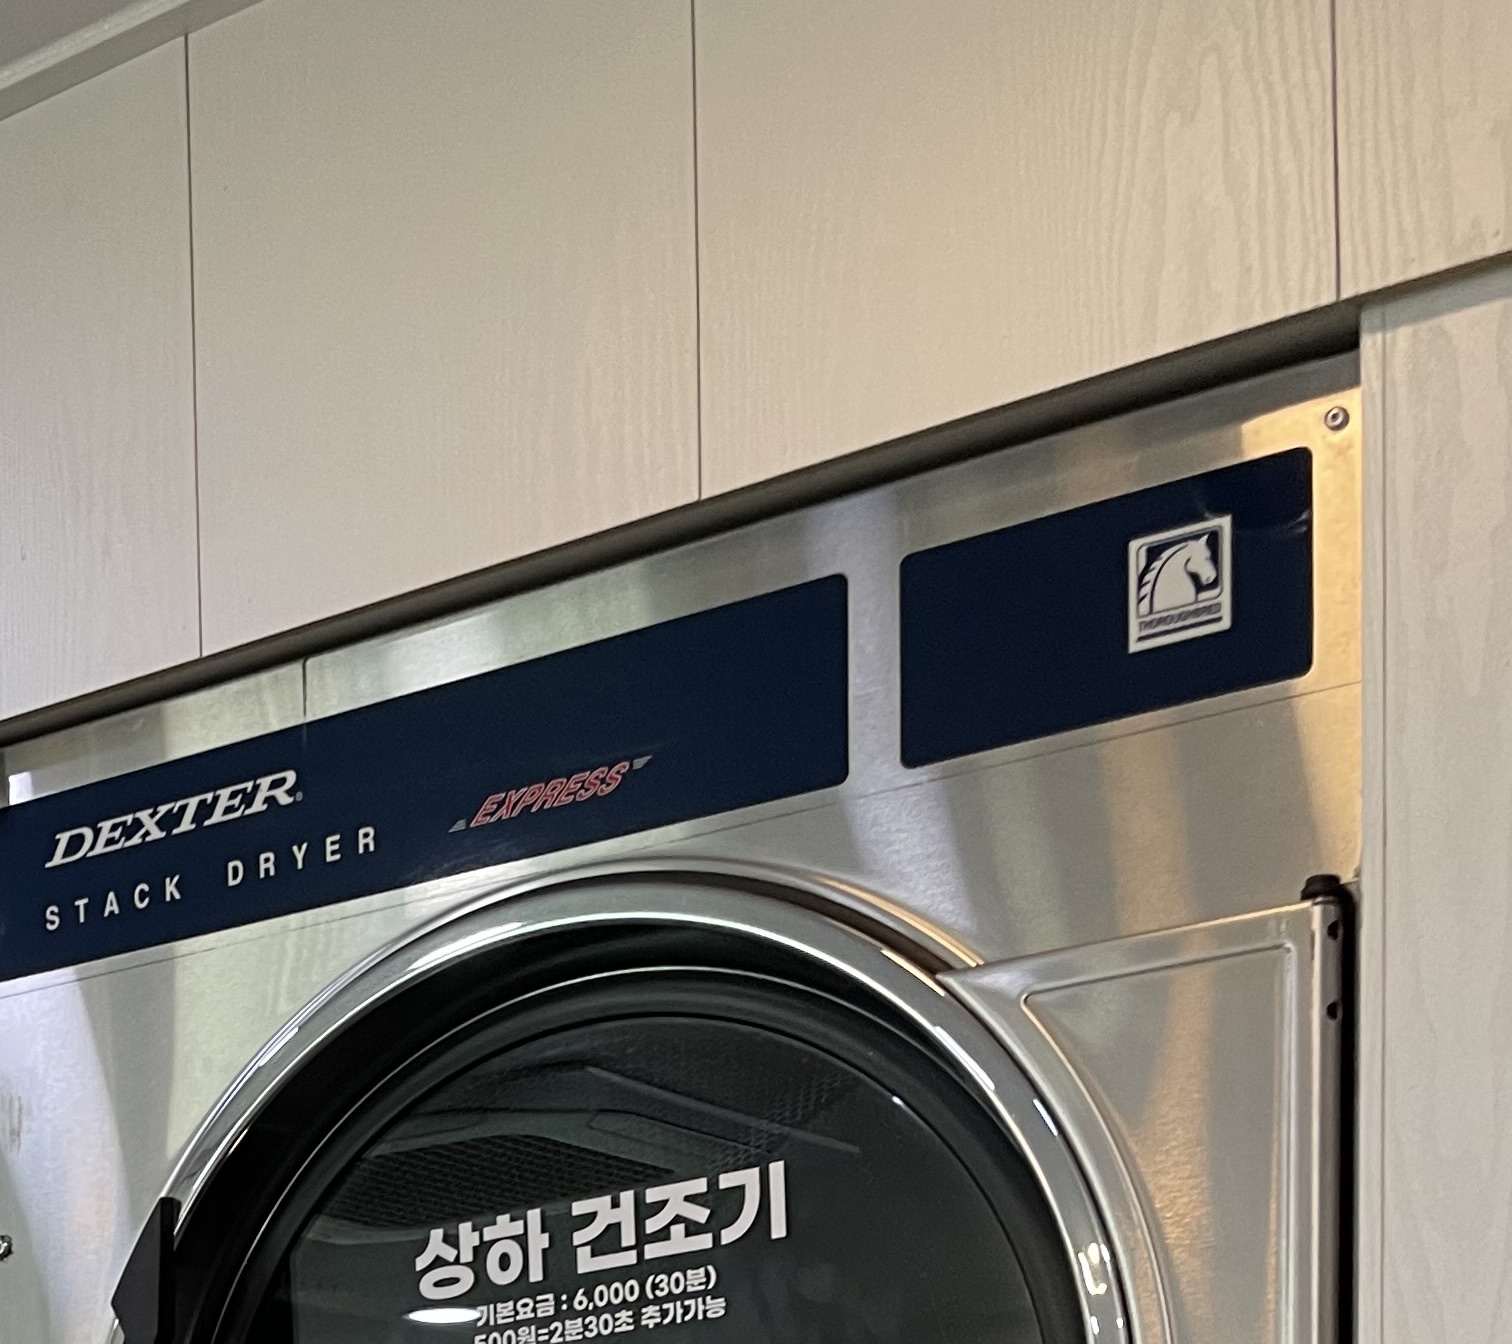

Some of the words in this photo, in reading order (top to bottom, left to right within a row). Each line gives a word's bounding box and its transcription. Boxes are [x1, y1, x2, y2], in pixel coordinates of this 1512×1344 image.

[45, 769, 296, 868] DEXTER
[470, 761, 631, 828] EXPRESS
[45, 875, 181, 931] STACK
[228, 827, 377, 887] DRYER
[416, 1208, 549, 1299] 상하
[572, 1160, 786, 1274] 건조기
[476, 1293, 555, 1327] 기본요금
[573, 1279, 639, 1310] 6,000
[646, 1265, 716, 1299] (30분)
[641, 1296, 726, 1328] 추가가능
